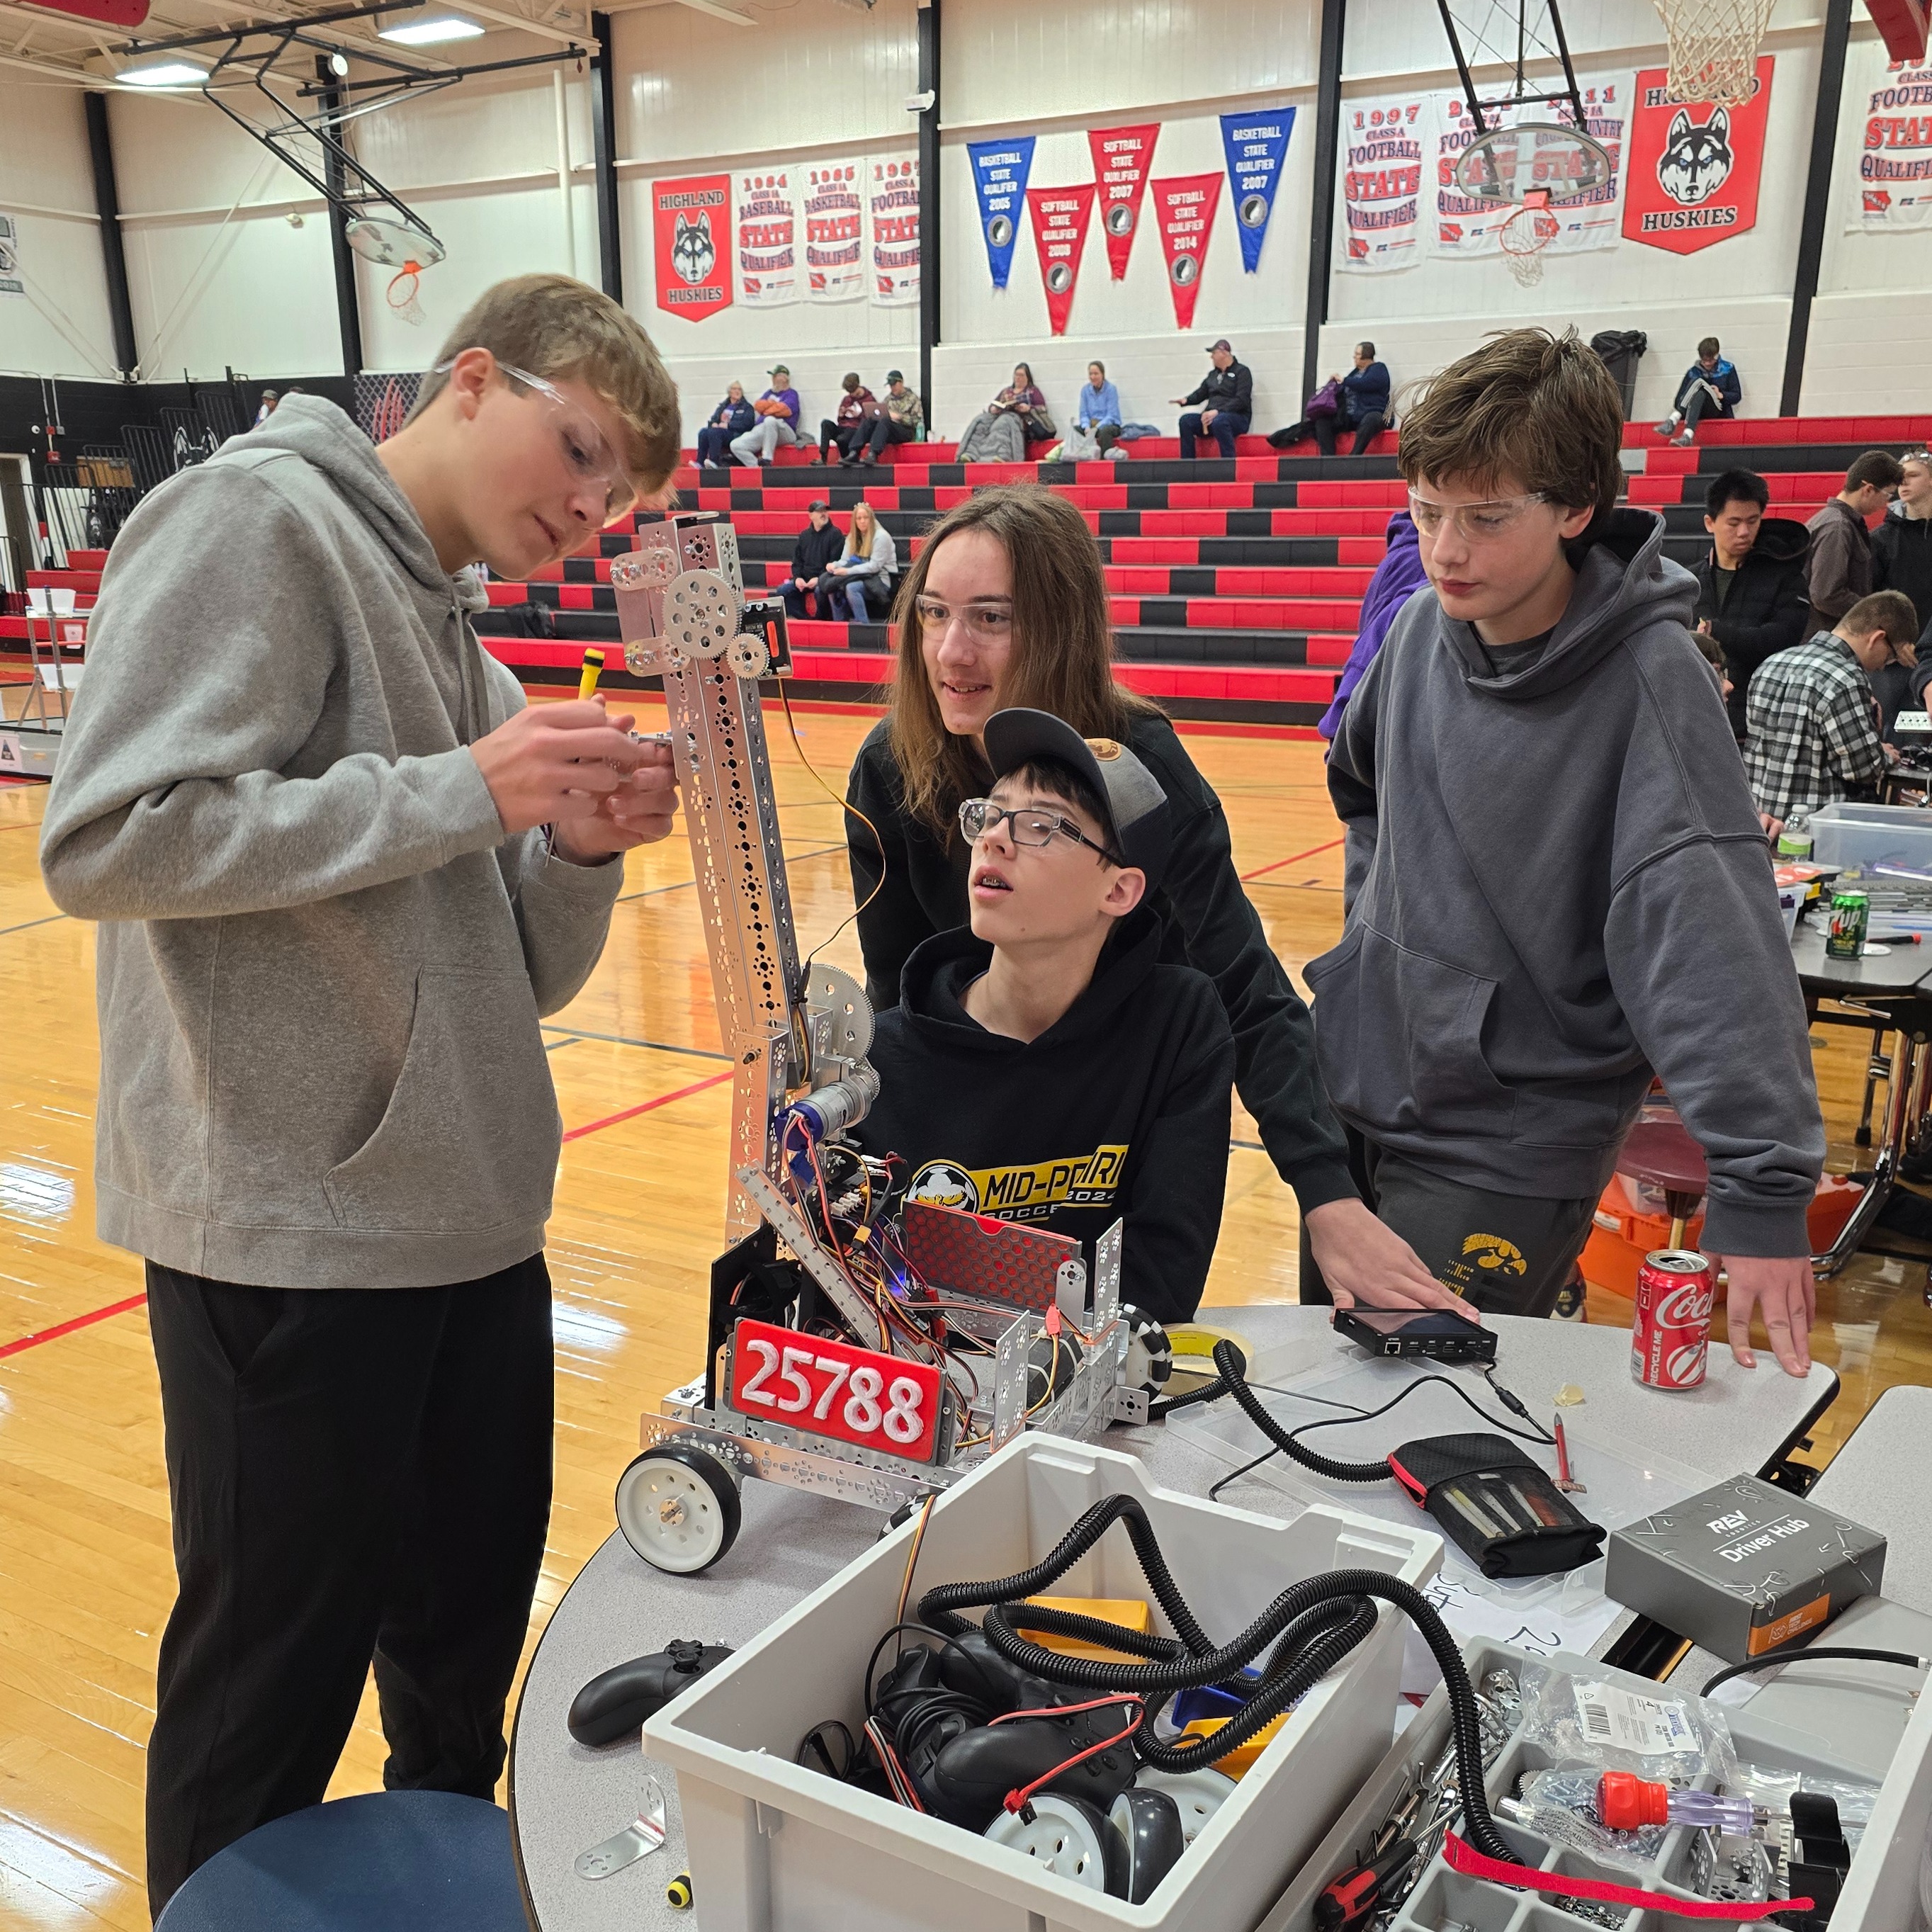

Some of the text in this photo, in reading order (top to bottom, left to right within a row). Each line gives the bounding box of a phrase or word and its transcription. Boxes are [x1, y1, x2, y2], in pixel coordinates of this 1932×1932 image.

[1353, 104, 1420, 130] 1997
[1233, 126, 1282, 141] BASKETBALL
[1366, 126, 1406, 142] CLASS A
[1103, 138, 1143, 152] SOFTBALL
[1243, 144, 1268, 157] STATE
[1348, 140, 1421, 168] FOOTBALL
[979, 152, 1022, 167] BASKETBALL
[1111, 154, 1134, 168] STATE
[990, 169, 1011, 181] STATE
[1242, 175, 1268, 190] 2007
[1345, 164, 1421, 202] STATE
[660, 188, 725, 209] HIGHLAND
[1109, 184, 1134, 198] 2007
[1167, 190, 1206, 205] SOFTBALL
[739, 200, 793, 222] BASEBALL
[804, 193, 861, 215] BASKETBALL
[1040, 200, 1080, 213] SOFTBALL
[1175, 206, 1198, 220] STATE
[1347, 198, 1416, 229] QUALIFIER
[807, 213, 861, 242] STATE
[1049, 214, 1071, 226] STATE
[1642, 206, 1736, 231] HUSKIES
[739, 219, 793, 248] STATE
[1173, 235, 1197, 250] 2014
[740, 247, 793, 271] QUALIFIER
[807, 240, 860, 265] QUALIFIER
[668, 286, 723, 303] HUSKIES
[1650, 1329, 1663, 1384] RECYCLE ME
[742, 1339, 924, 1443] 25788
[1706, 1510, 1749, 1534] REV
[1719, 1519, 1810, 1563] Driver Hub
